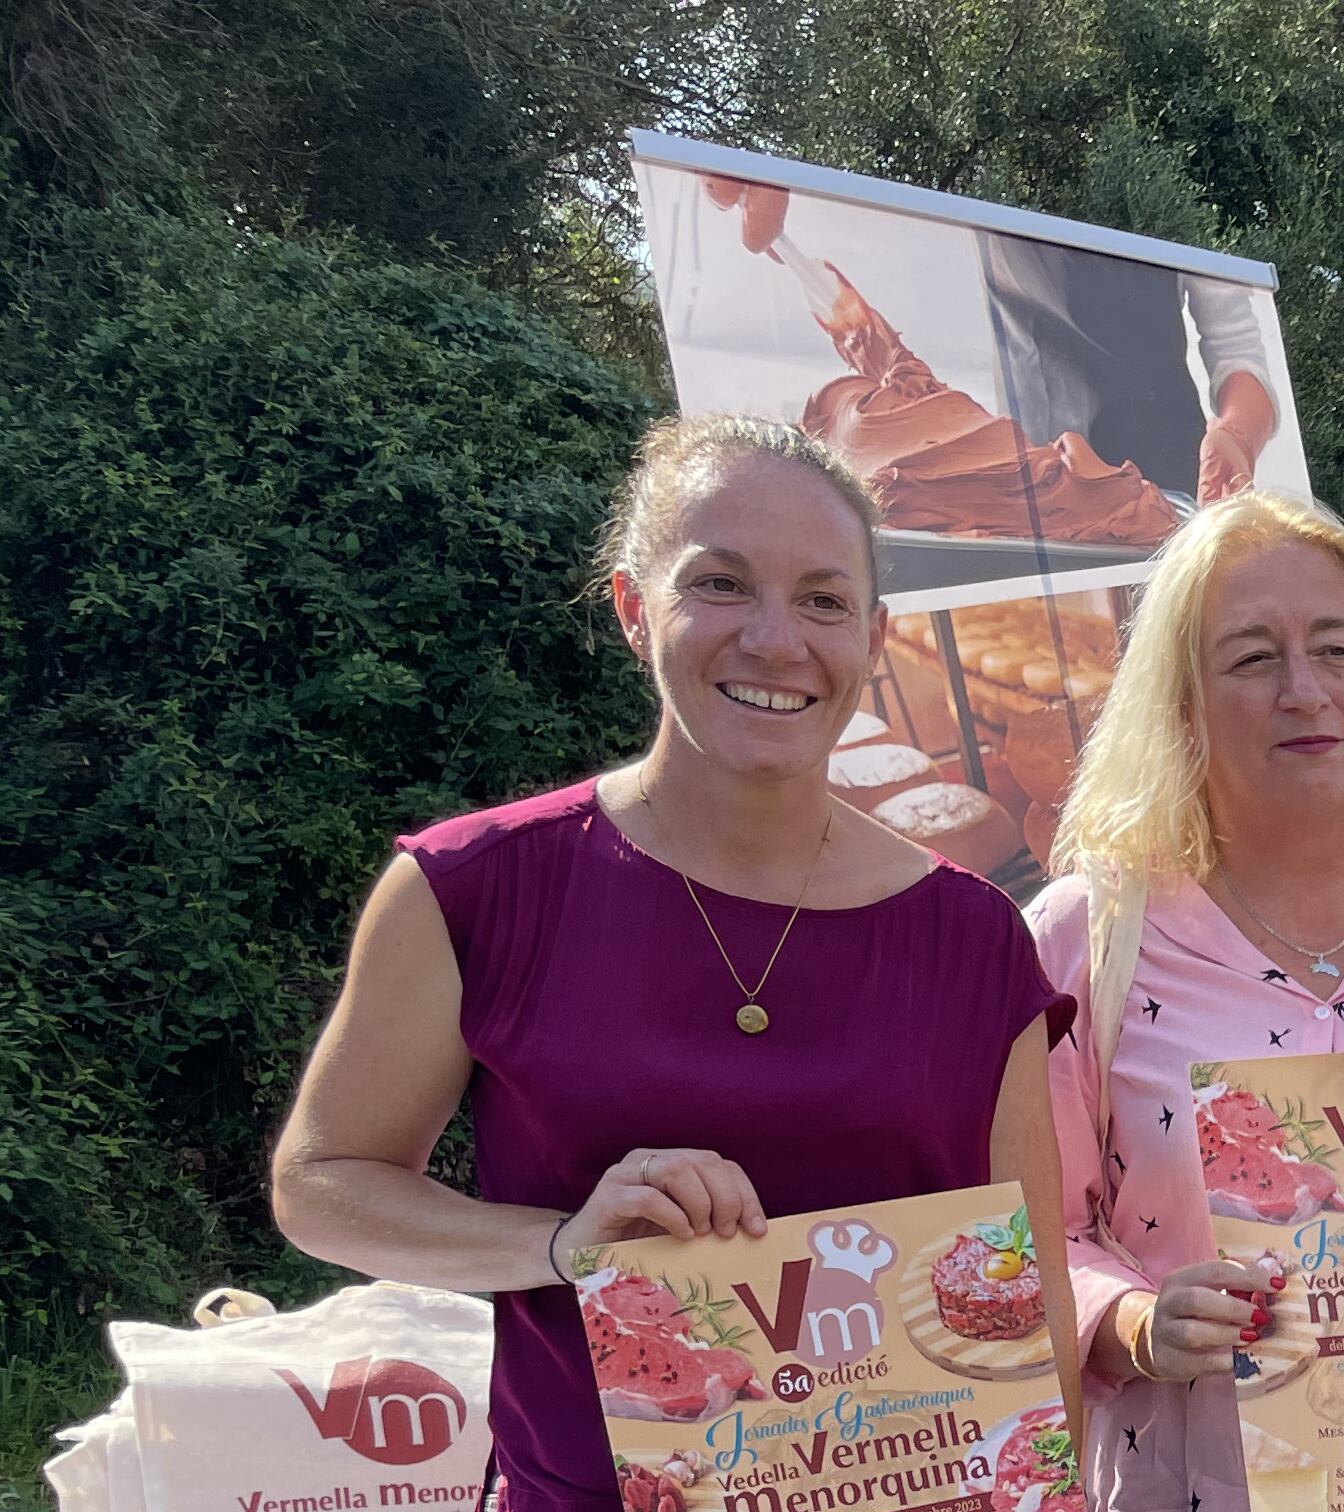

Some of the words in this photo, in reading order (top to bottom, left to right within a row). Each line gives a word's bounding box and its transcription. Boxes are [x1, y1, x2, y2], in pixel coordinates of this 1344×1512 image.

[815, 1353, 890, 1388] edició
[716, 1462, 800, 1492] Vedella
[791, 1411, 984, 1475] Vermella
[379, 1482, 481, 1506] menor
